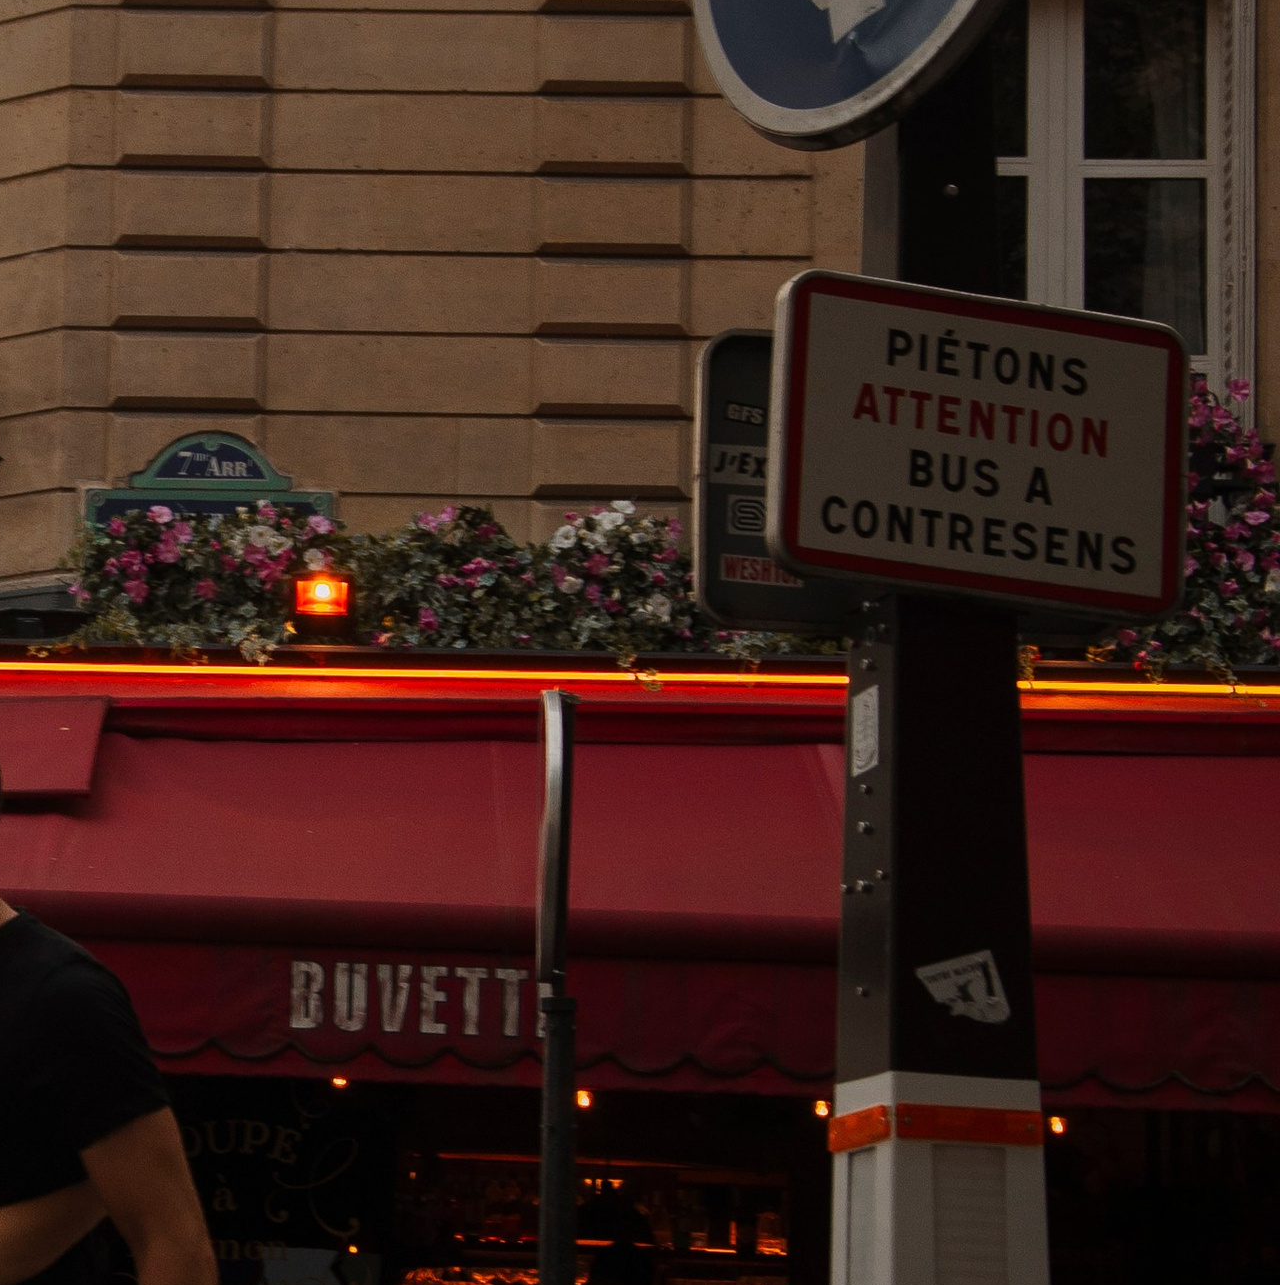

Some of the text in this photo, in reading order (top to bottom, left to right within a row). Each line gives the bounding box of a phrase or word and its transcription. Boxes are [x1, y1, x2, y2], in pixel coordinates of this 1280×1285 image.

[887, 329, 1088, 396] PIÉTONS
[853, 383, 1108, 458] ATTENTION
[909, 449, 1053, 506] BUS A
[821, 494, 1137, 575] CONTRESENS
